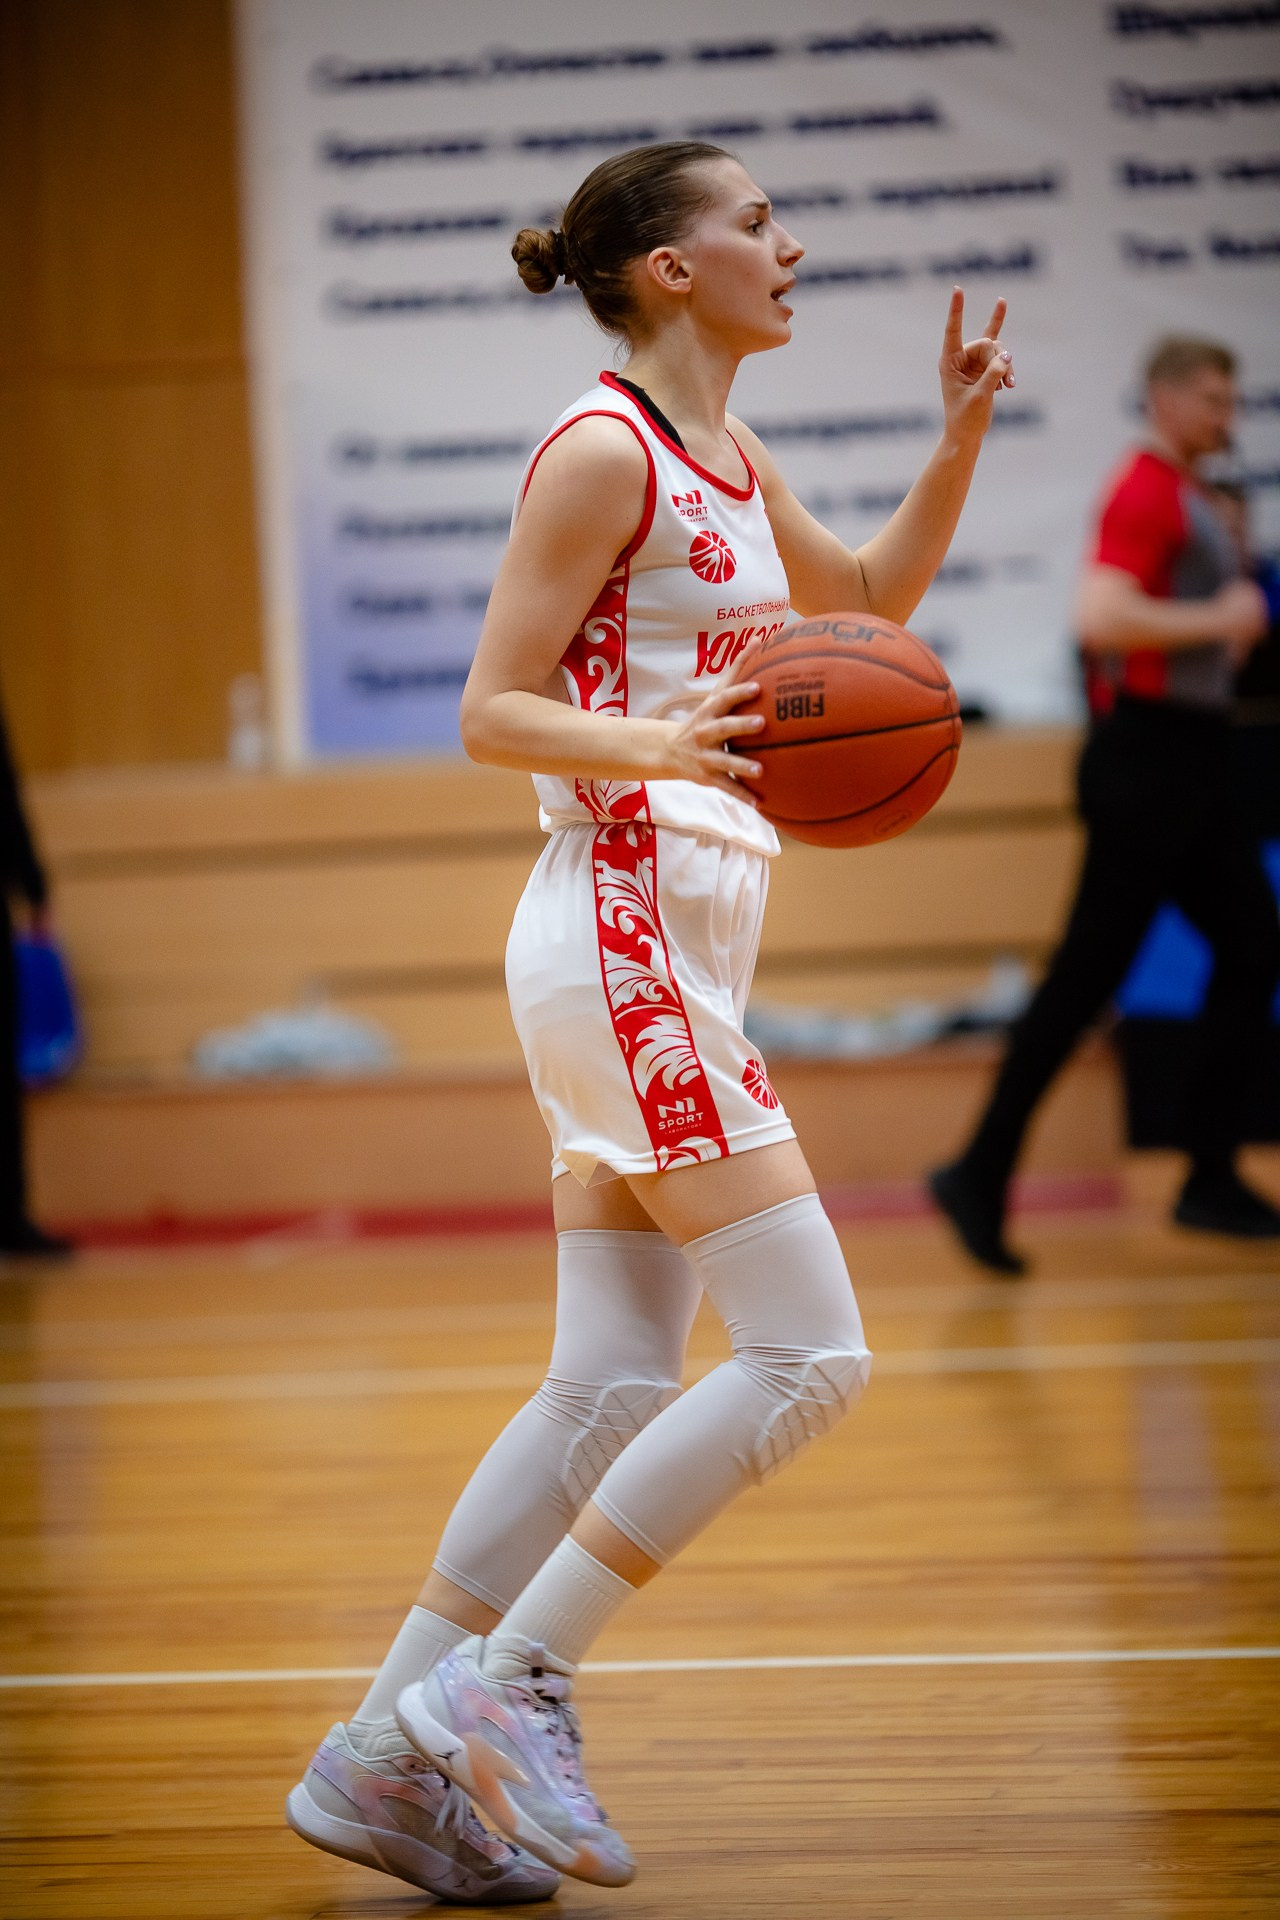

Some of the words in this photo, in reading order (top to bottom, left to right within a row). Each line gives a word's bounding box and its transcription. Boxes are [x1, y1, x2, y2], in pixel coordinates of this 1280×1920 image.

[679, 505, 708, 517] PORT
[776, 693, 824, 721] FIBA
[658, 1111, 704, 1131] SPORT
